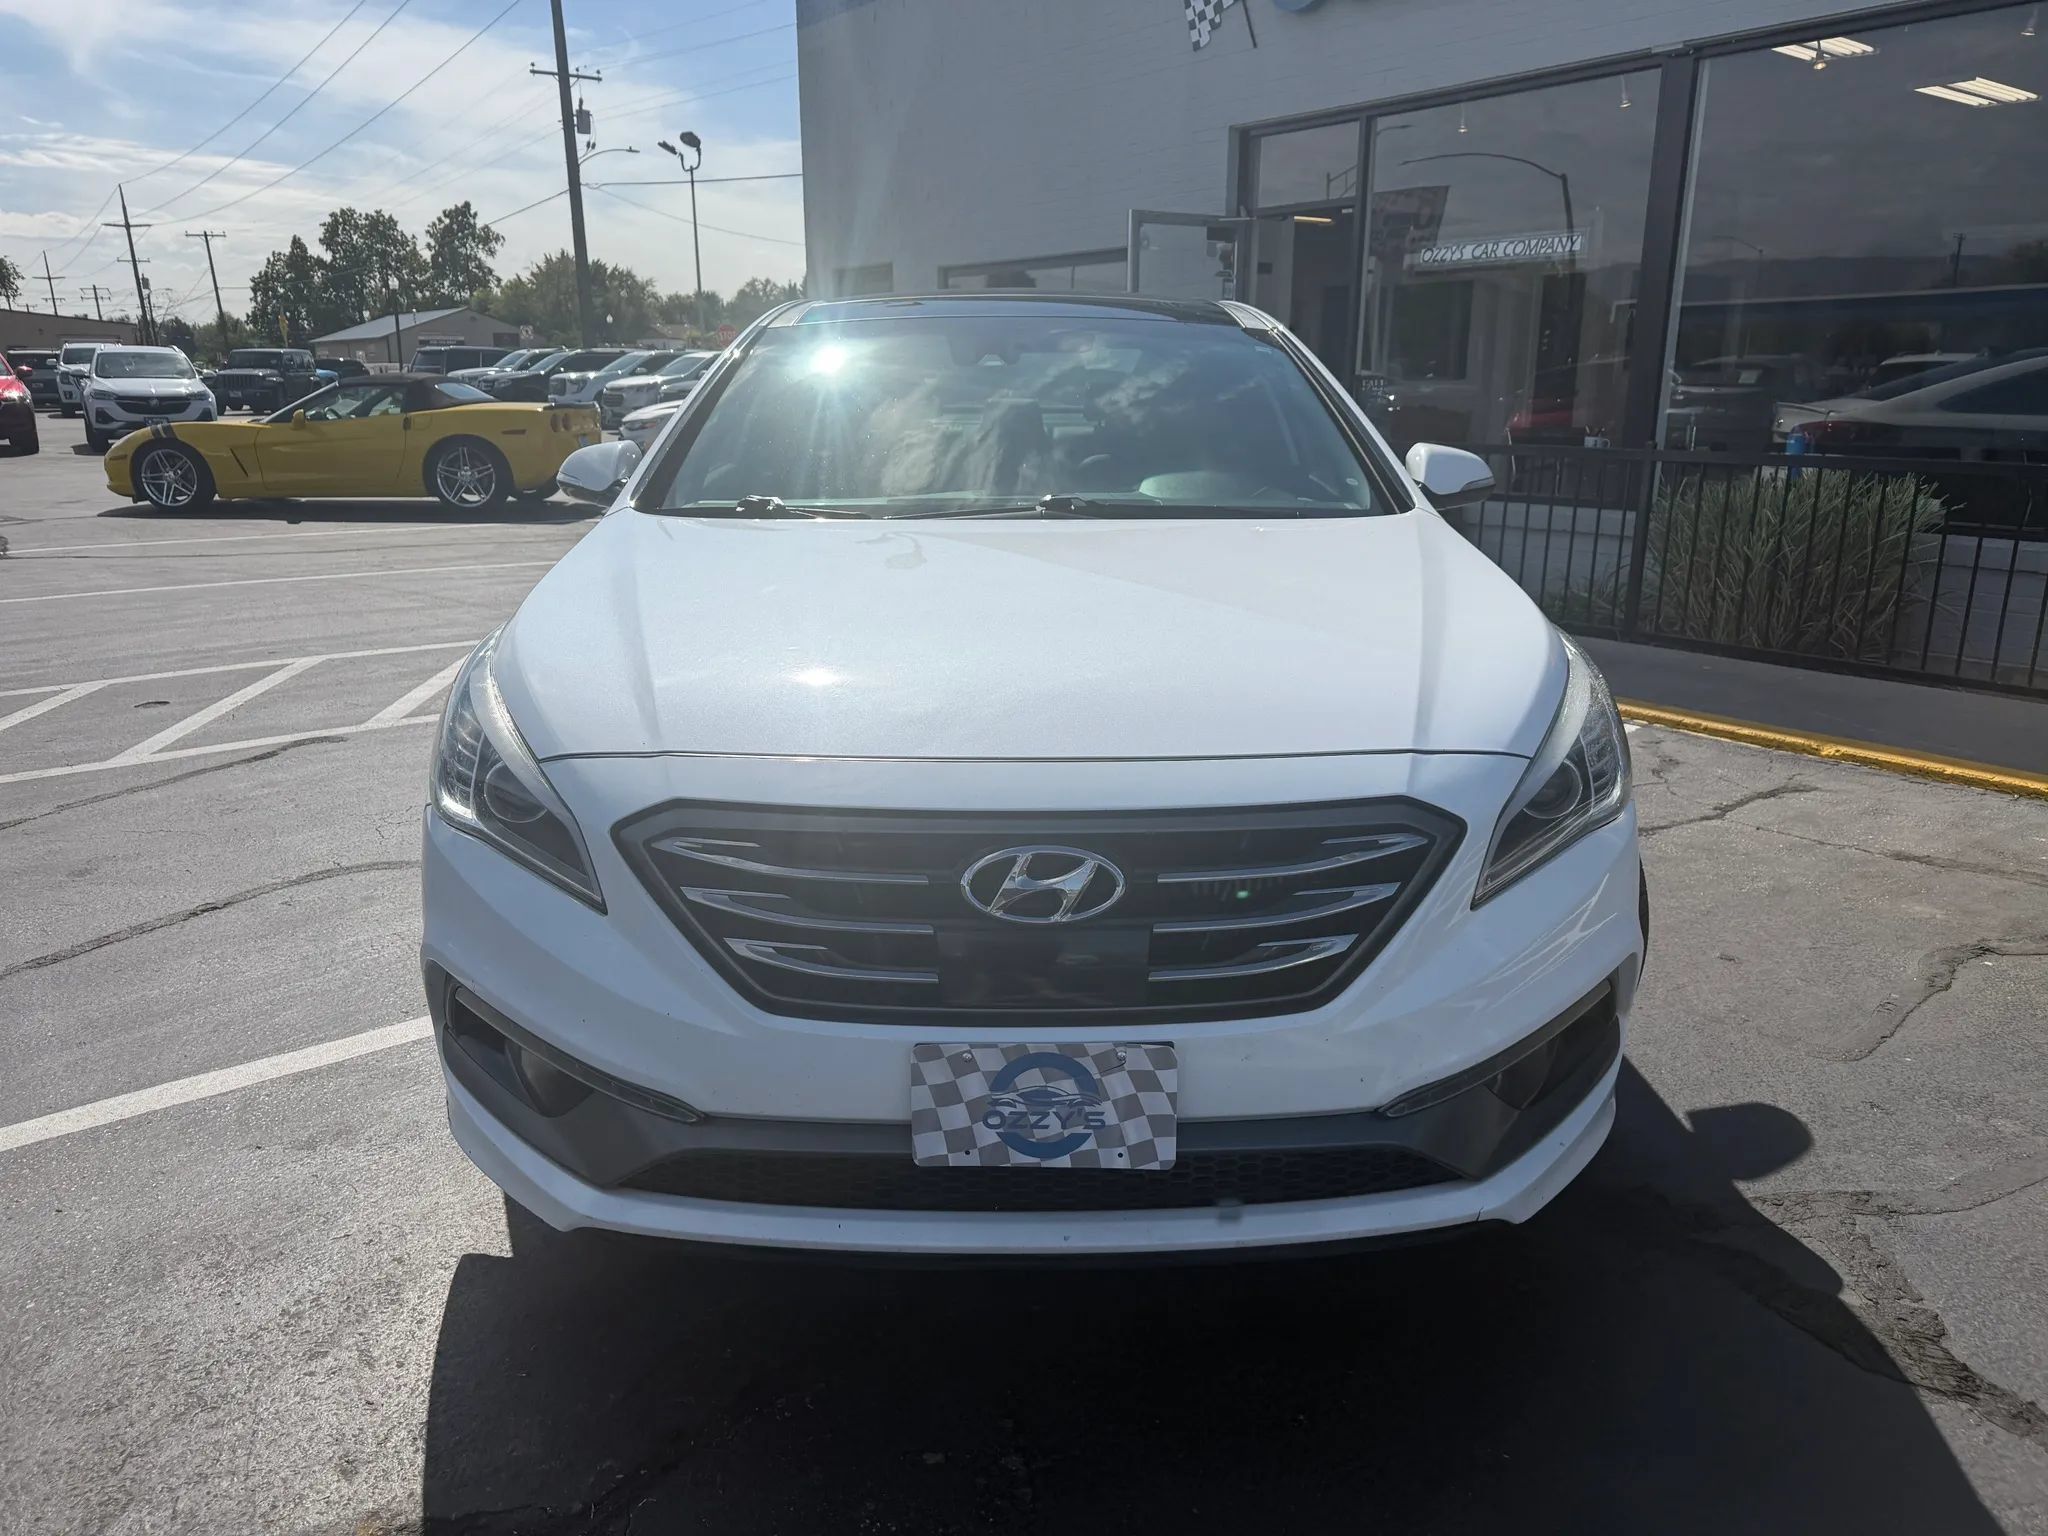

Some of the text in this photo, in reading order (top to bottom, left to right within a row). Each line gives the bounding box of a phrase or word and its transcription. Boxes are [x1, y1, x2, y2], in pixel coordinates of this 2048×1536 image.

[1472, 241, 1499, 260] CAR
[1503, 234, 1582, 257] COMPANY
[982, 1108, 1107, 1131] OZZY'S
